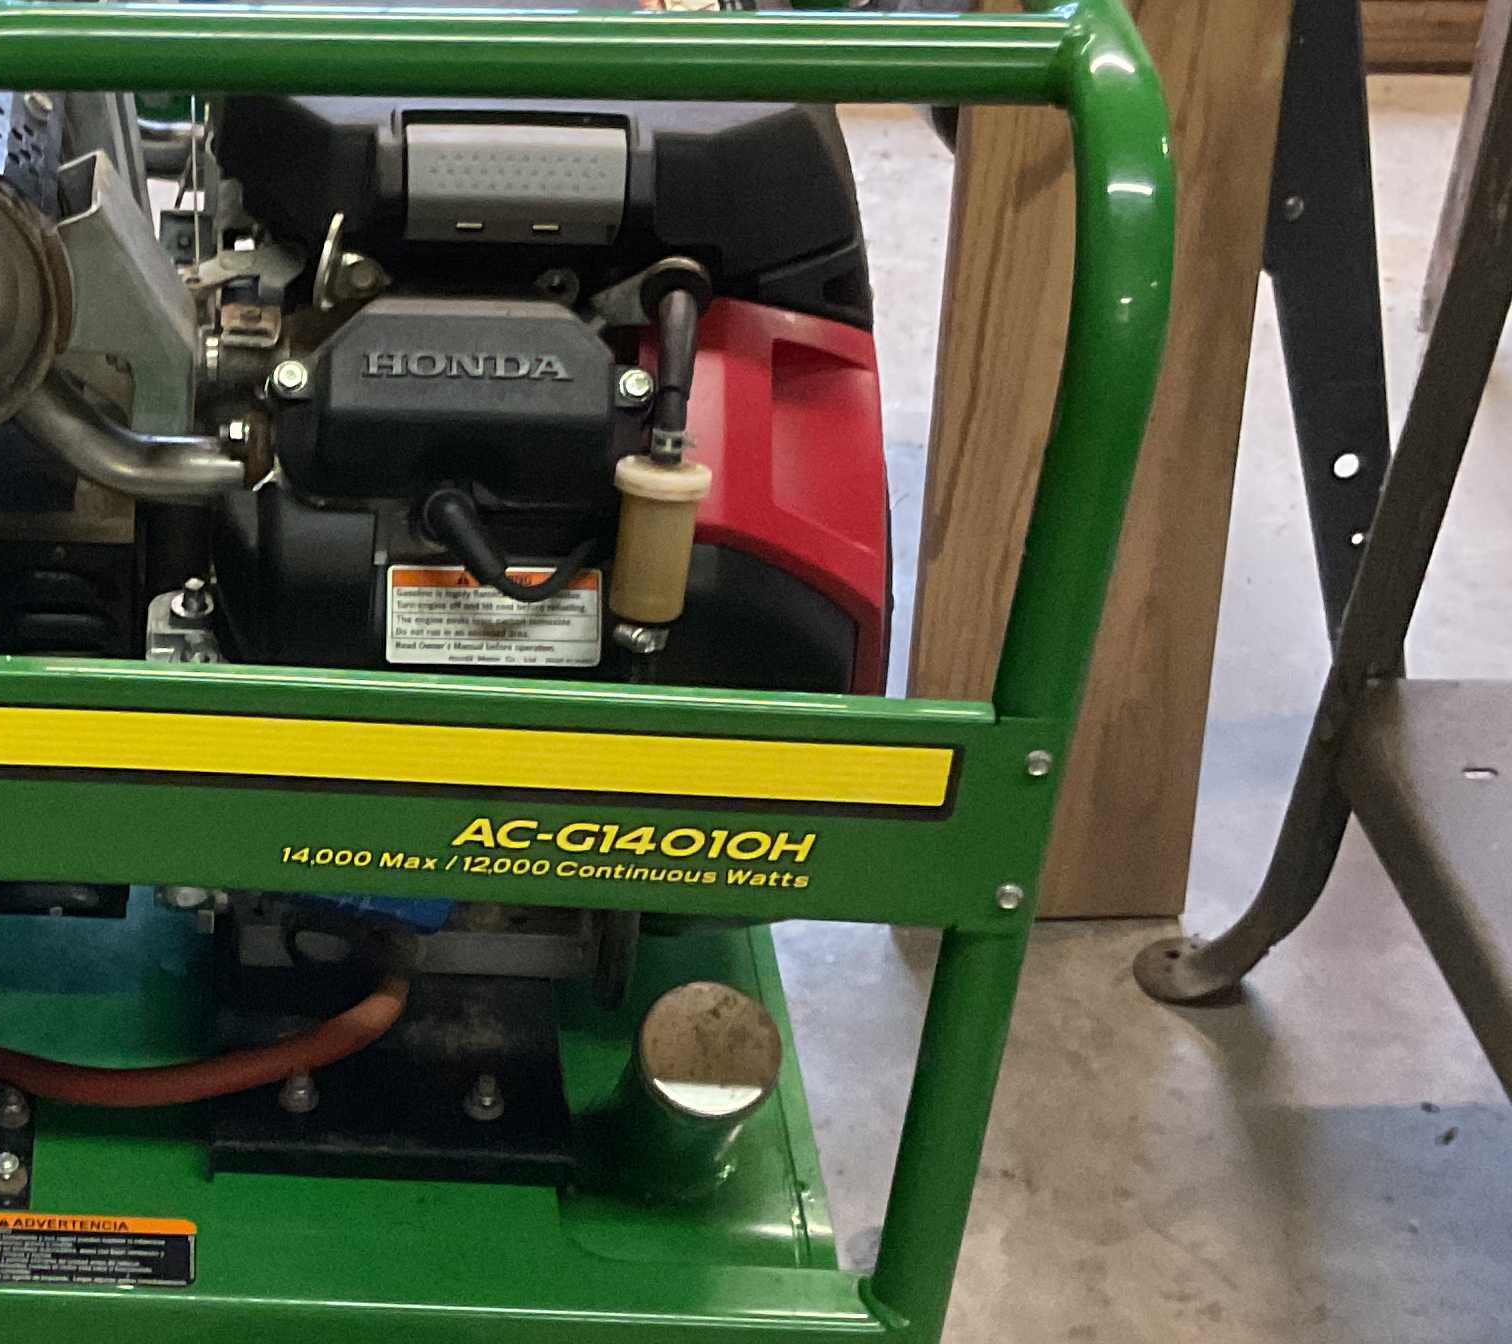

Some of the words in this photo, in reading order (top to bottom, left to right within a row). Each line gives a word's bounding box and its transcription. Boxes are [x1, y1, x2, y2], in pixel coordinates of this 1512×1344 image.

[364, 350, 573, 381] HONDA
[451, 817, 817, 862] AC-G14010H
[281, 846, 373, 868] 14,000
[378, 852, 439, 872] Max
[445, 855, 459, 871] /
[462, 856, 551, 876] 12,000
[555, 860, 717, 885] Continuous
[726, 868, 811, 888] Watts
[12, 1217, 130, 1232] ADVERTENCIA
